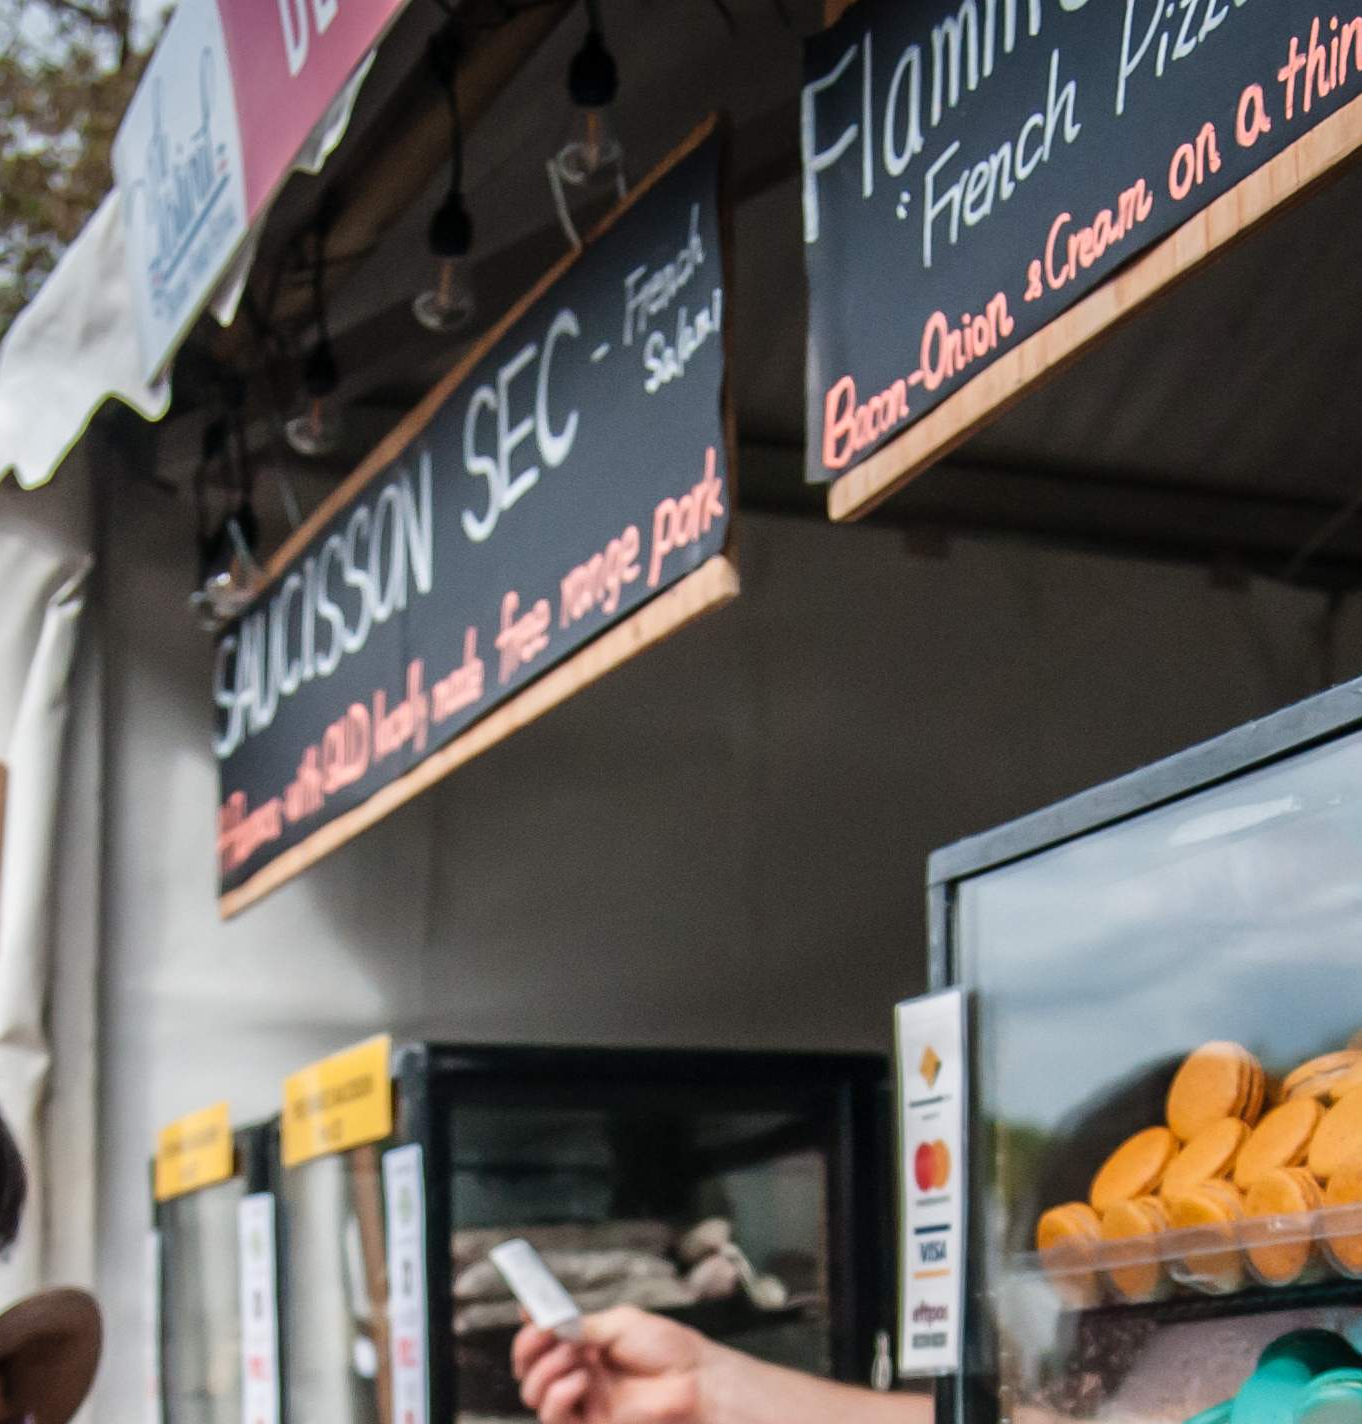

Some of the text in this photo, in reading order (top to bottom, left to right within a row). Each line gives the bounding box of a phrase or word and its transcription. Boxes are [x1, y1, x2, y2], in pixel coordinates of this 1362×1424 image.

[1168, 122, 1222, 200] on
[1235, 82, 1271, 148] a
[212, 450, 434, 760] SAUCISSON
[461, 308, 579, 543] SEC
[494, 590, 550, 685] free
[560, 524, 641, 630] range
[647, 446, 724, 588] pork
[919, 1239, 947, 1264] VISA
